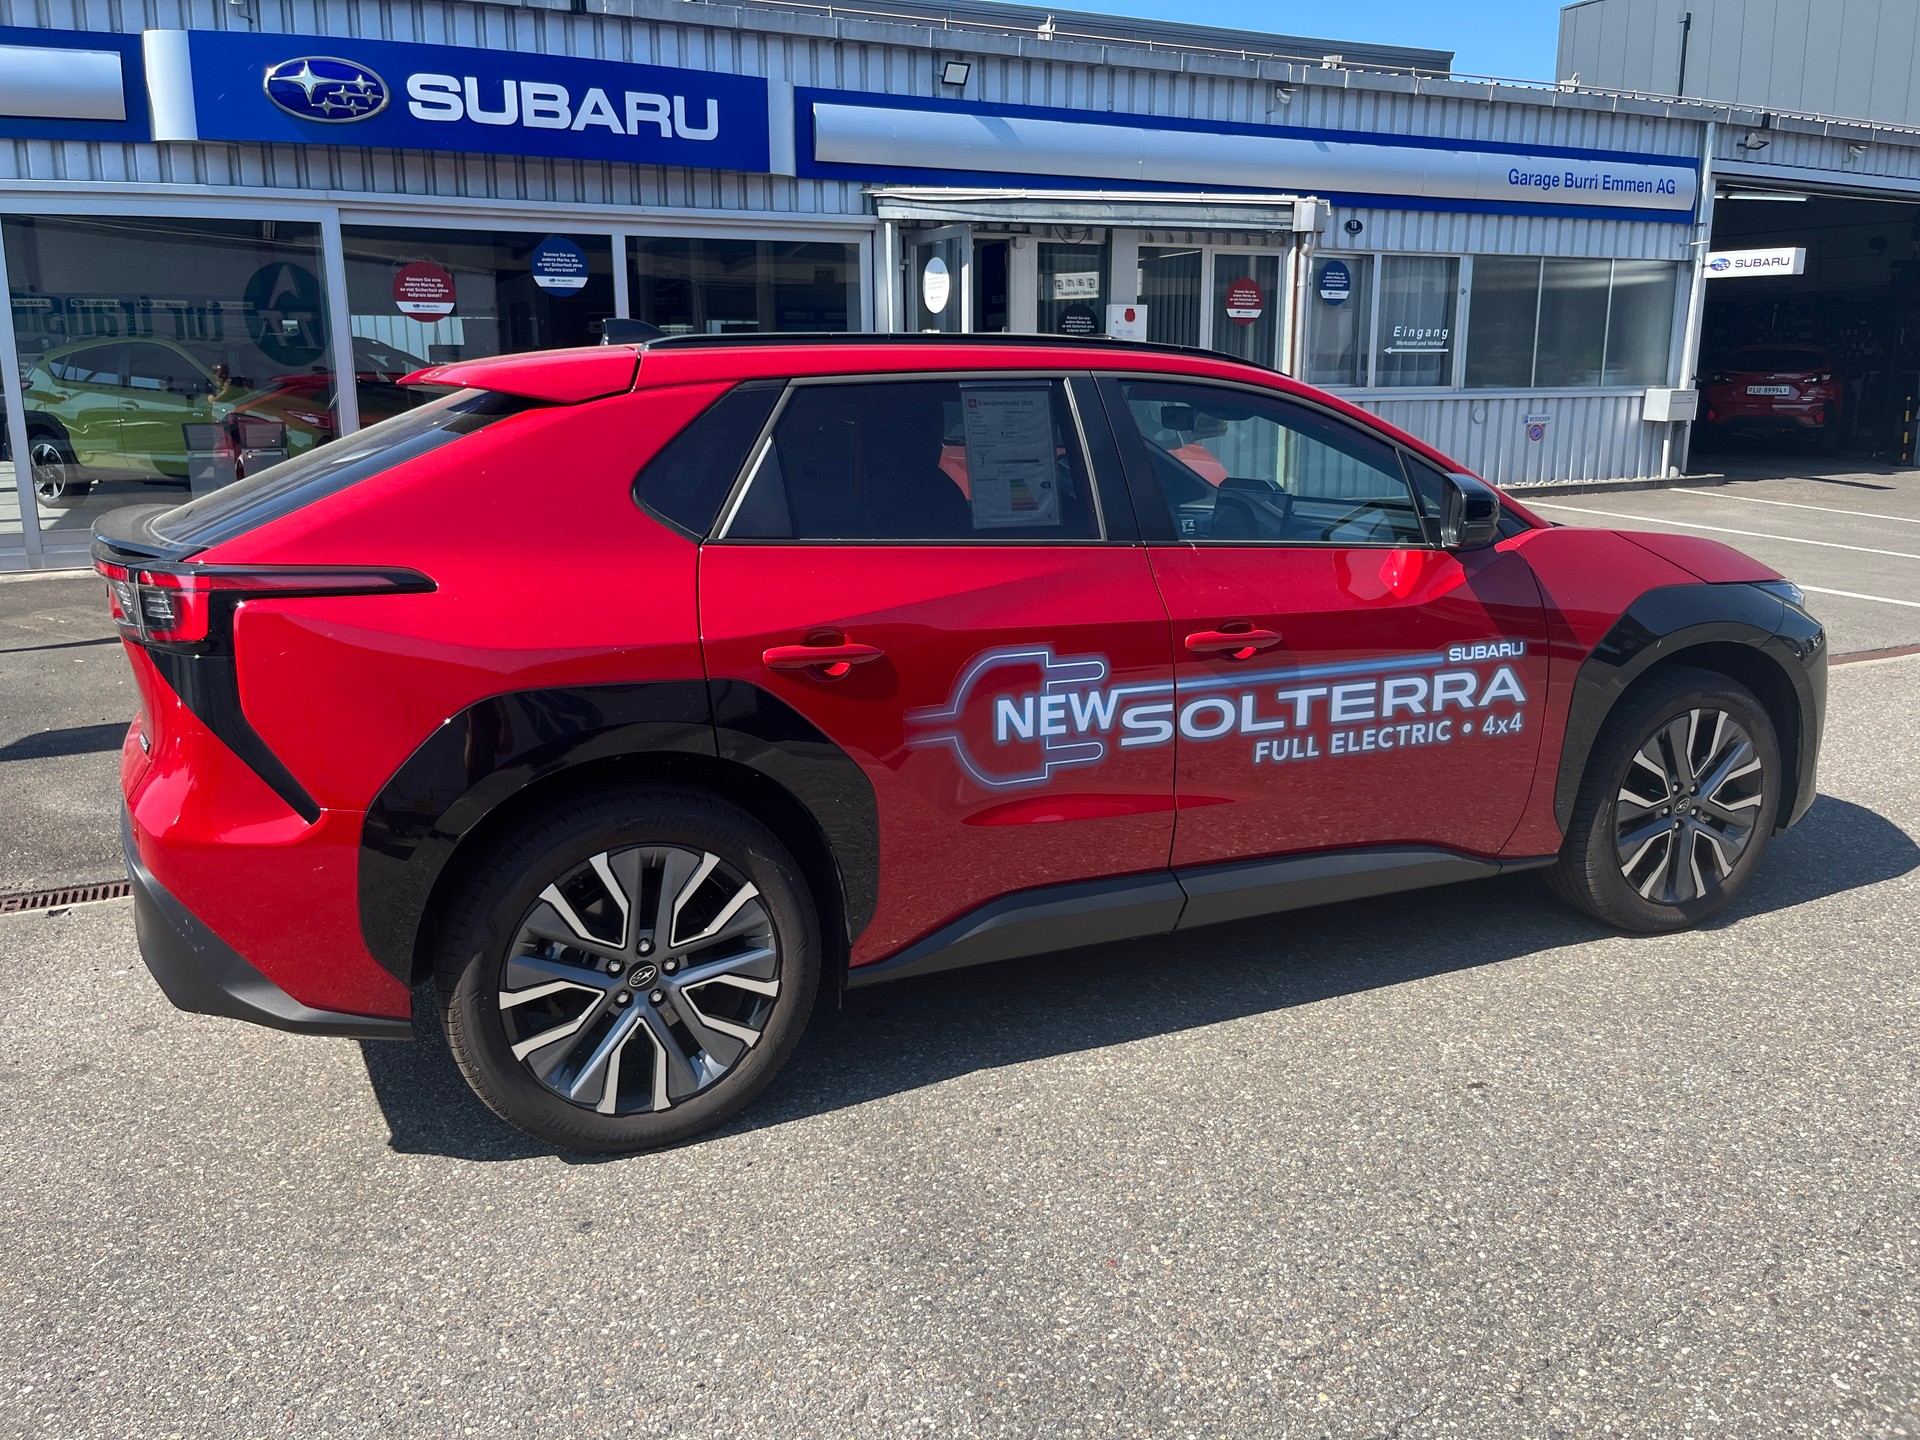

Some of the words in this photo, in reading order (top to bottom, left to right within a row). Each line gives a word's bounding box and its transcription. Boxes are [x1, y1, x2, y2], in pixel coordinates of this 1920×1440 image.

[406, 73, 719, 141] SUBARU
[1508, 168, 1560, 190] Garage
[1564, 172, 1598, 190] Burri
[1602, 174, 1653, 194] Emmen
[1656, 178, 1676, 195] AG
[1735, 257, 1790, 268] SUBARU
[1393, 326, 1449, 340] Eingang
[1448, 642, 1525, 664] SUBARU
[997, 690, 1121, 742] NEW
[1120, 667, 1527, 747] SOLTERRA
[1254, 735, 1320, 764] FULL
[1331, 720, 1451, 756] ELECTRIC
[1481, 712, 1522, 736] 4x4
